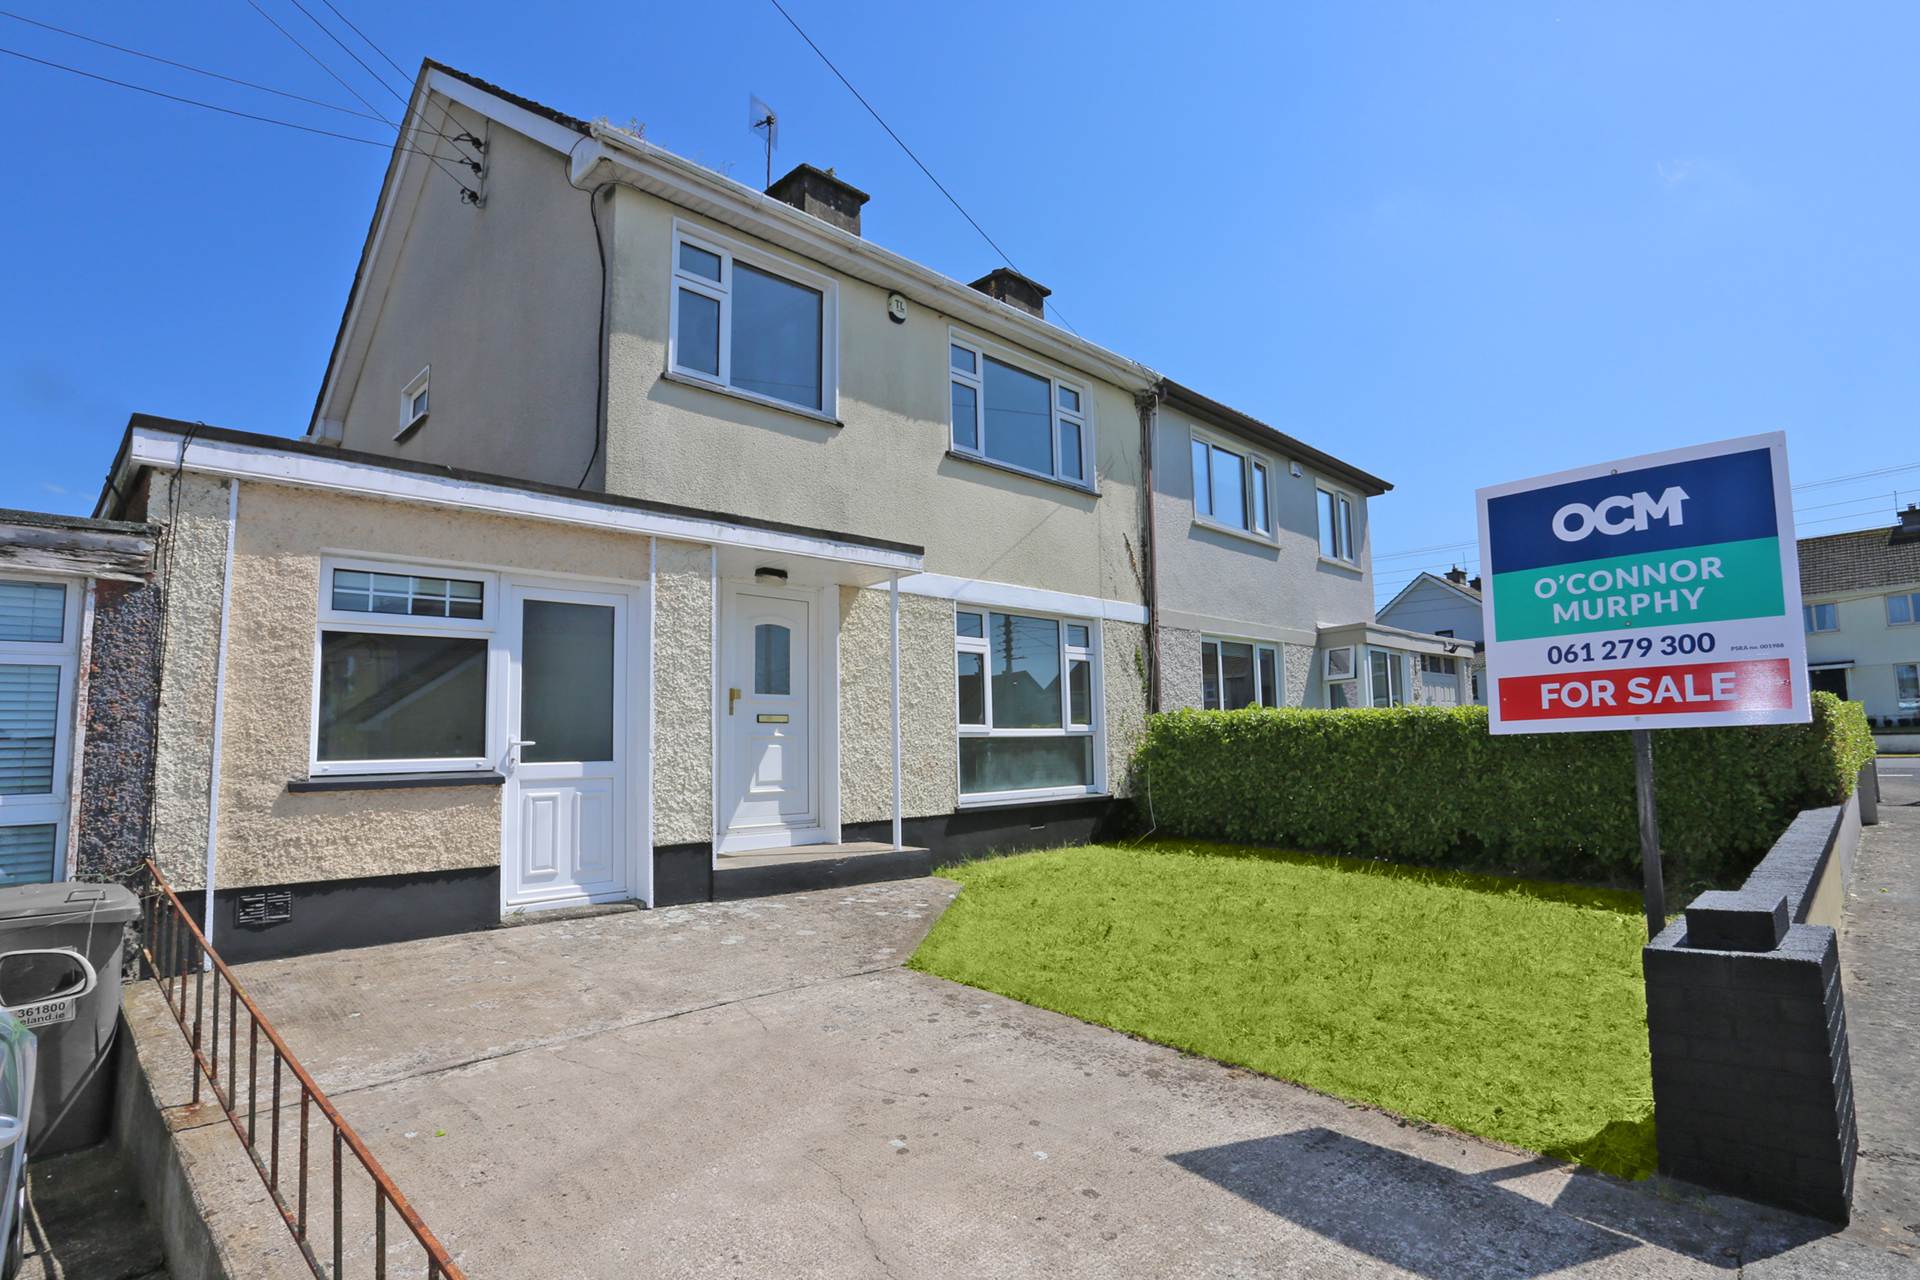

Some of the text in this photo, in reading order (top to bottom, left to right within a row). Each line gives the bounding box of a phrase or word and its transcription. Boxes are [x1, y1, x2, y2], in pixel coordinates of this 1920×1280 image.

[1552, 487, 1690, 542] OCM
[1534, 557, 1724, 599] O'CONNOR
[1553, 587, 1705, 624] MURPHY
[1548, 632, 1716, 665] 061 279 300
[1540, 671, 1739, 710] FOR SALE
